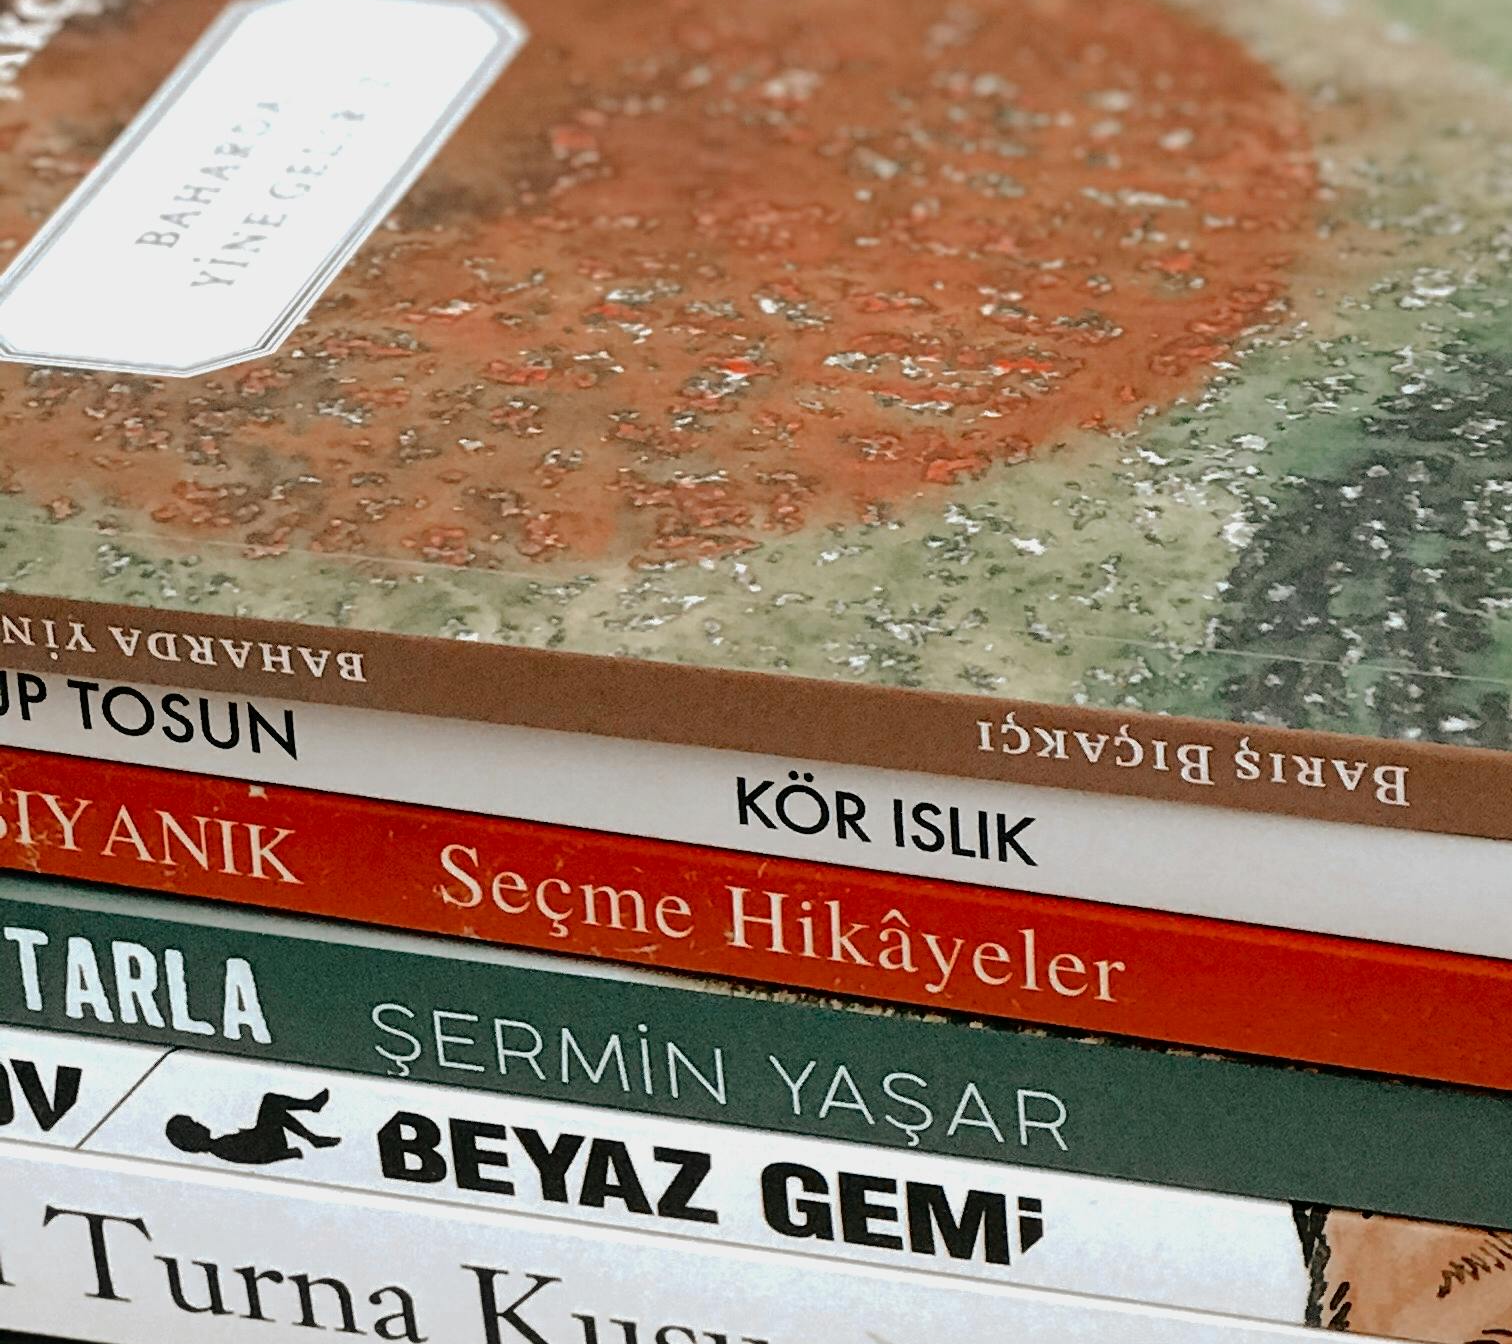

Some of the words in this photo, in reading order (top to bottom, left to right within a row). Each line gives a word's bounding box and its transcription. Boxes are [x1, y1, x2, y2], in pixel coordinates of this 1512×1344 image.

[108, 625, 367, 683] BAHARDA
[67, 678, 297, 760] TOSUN
[736, 770, 871, 843] KÖR
[893, 799, 1038, 866] ISLIK
[438, 843, 694, 940] Seçme
[725, 885, 1126, 1002] Hikâyeler
[3, 927, 272, 1044] TARLA
[371, 1001, 727, 1105] ŞERMİN
[769, 1055, 1069, 1152] YAŞAR
[377, 1111, 719, 1224] BEYAZ
[43, 1205, 428, 1344] Turna
